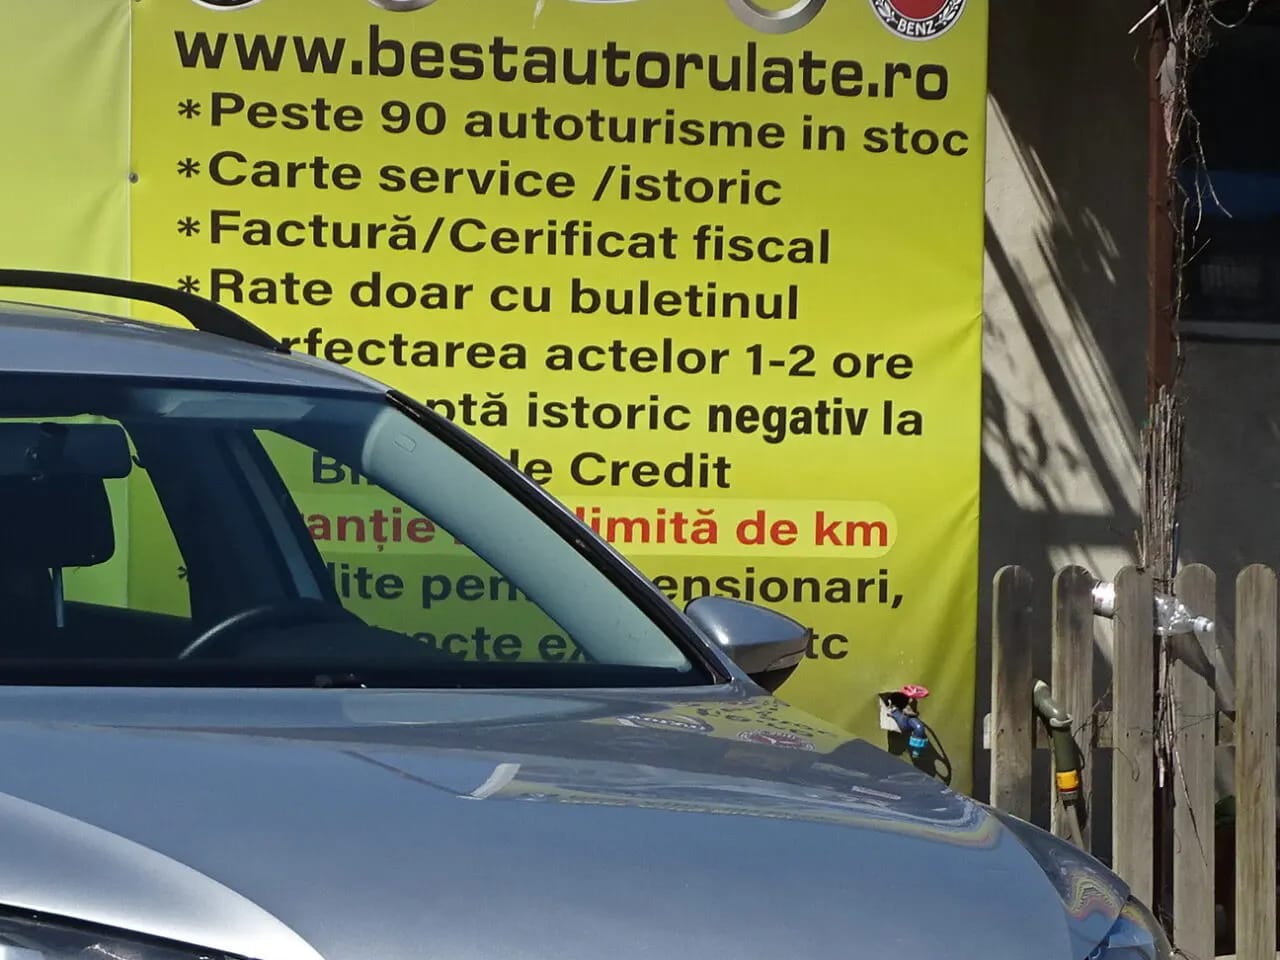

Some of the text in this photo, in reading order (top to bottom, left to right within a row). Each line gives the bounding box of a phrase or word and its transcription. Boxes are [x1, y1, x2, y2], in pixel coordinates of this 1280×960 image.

[897, 18, 936, 36] BENZ
[175, 25, 949, 100] www.bestautorulate.ro
[380, 101, 446, 136] 90
[464, 108, 785, 149] autoturisme
[802, 115, 845, 151] in
[863, 121, 969, 156] stoc
[378, 160, 576, 199] service
[592, 164, 782, 206] /istoric
[693, 225, 830, 264] fiscal
[350, 271, 473, 310] doar
[490, 285, 551, 313] cu
[571, 278, 799, 320] buletinul
[545, 338, 730, 374] actelor
[746, 344, 816, 377] 1-2
[832, 352, 914, 380] ore
[527, 392, 691, 431] istoric
[708, 397, 868, 445] negativ
[883, 400, 923, 437] la
[570, 452, 731, 488] Credit
[736, 509, 799, 546] de
[815, 510, 889, 547] km
